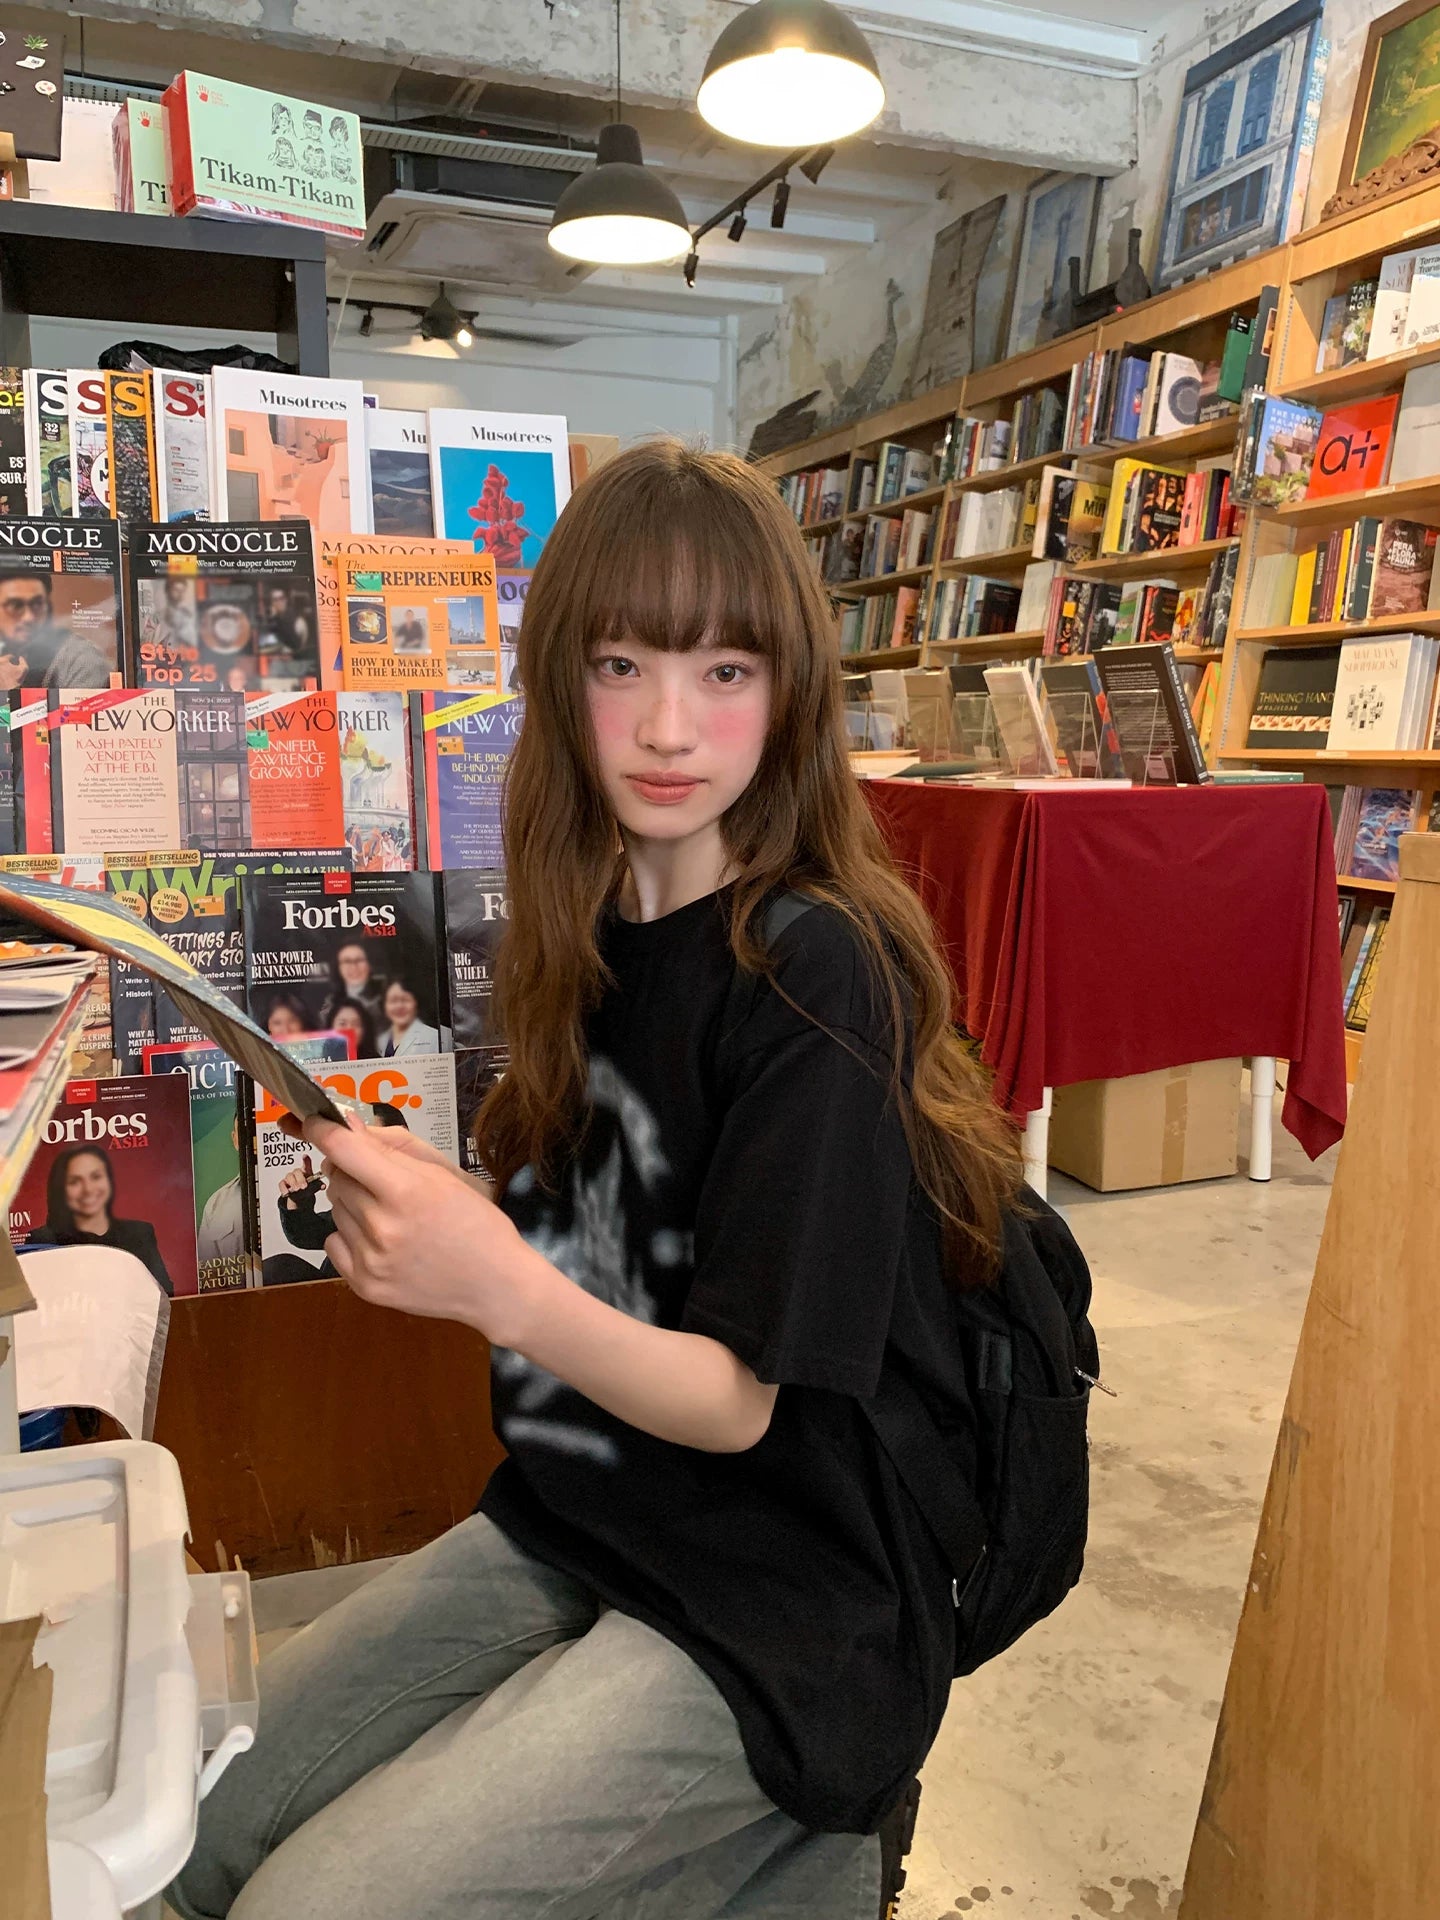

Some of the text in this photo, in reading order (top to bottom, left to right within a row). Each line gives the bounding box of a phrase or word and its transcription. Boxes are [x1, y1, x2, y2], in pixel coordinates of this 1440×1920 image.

[200, 156, 355, 210] Tikam-Tikam
[1352, 283, 1373, 294] THE
[1350, 292, 1376, 303] MAL
[259, 389, 347, 411] Musotrees
[471, 425, 553, 445] Musotrees
[1320, 430, 1380, 476] a+
[147, 531, 299, 553] MONOCLE
[1393, 540, 1413, 551] PERA
[236, 560, 262, 569] dapper
[263, 559, 297, 569] directory
[345, 560, 366, 570] The
[347, 571, 493, 587] EREPRENEURS
[140, 643, 199, 664] Style
[351, 657, 442, 667] HOW TO MAKE IT
[141, 664, 217, 685] Top 25
[351, 667, 444, 678] IN THE EMIRATES
[1171, 665, 1180, 685] WORLD
[141, 697, 168, 706] THE
[305, 698, 328, 707] THE
[1259, 692, 1306, 704] THINKING
[76, 737, 164, 749] KASH PATEL'S
[86, 750, 157, 762] VENDETTA
[463, 752, 483, 762] THE
[84, 763, 104, 774] AT
[104, 763, 130, 774] THE
[249, 765, 325, 780] GROWS UP
[452, 763, 489, 773] BEHIND
[149, 852, 198, 861] BESTSELLING
[6, 859, 58, 868] BESTSELLING
[121, 895, 138, 904] WIN
[163, 893, 179, 902] WIN
[281, 898, 396, 930] Forbes
[362, 923, 397, 936] Asia
[251, 950, 314, 966] ASIA'S POWER
[454, 953, 472, 966] BIG
[455, 966, 489, 980] WHEEL
[128, 1031, 145, 1039] WHY
[170, 1027, 186, 1035] WHY
[170, 1034, 202, 1042] MATTERS
[219, 1090, 236, 1098] TOD
[108, 1133, 149, 1150] Asia
[264, 1153, 295, 1168] 2025
